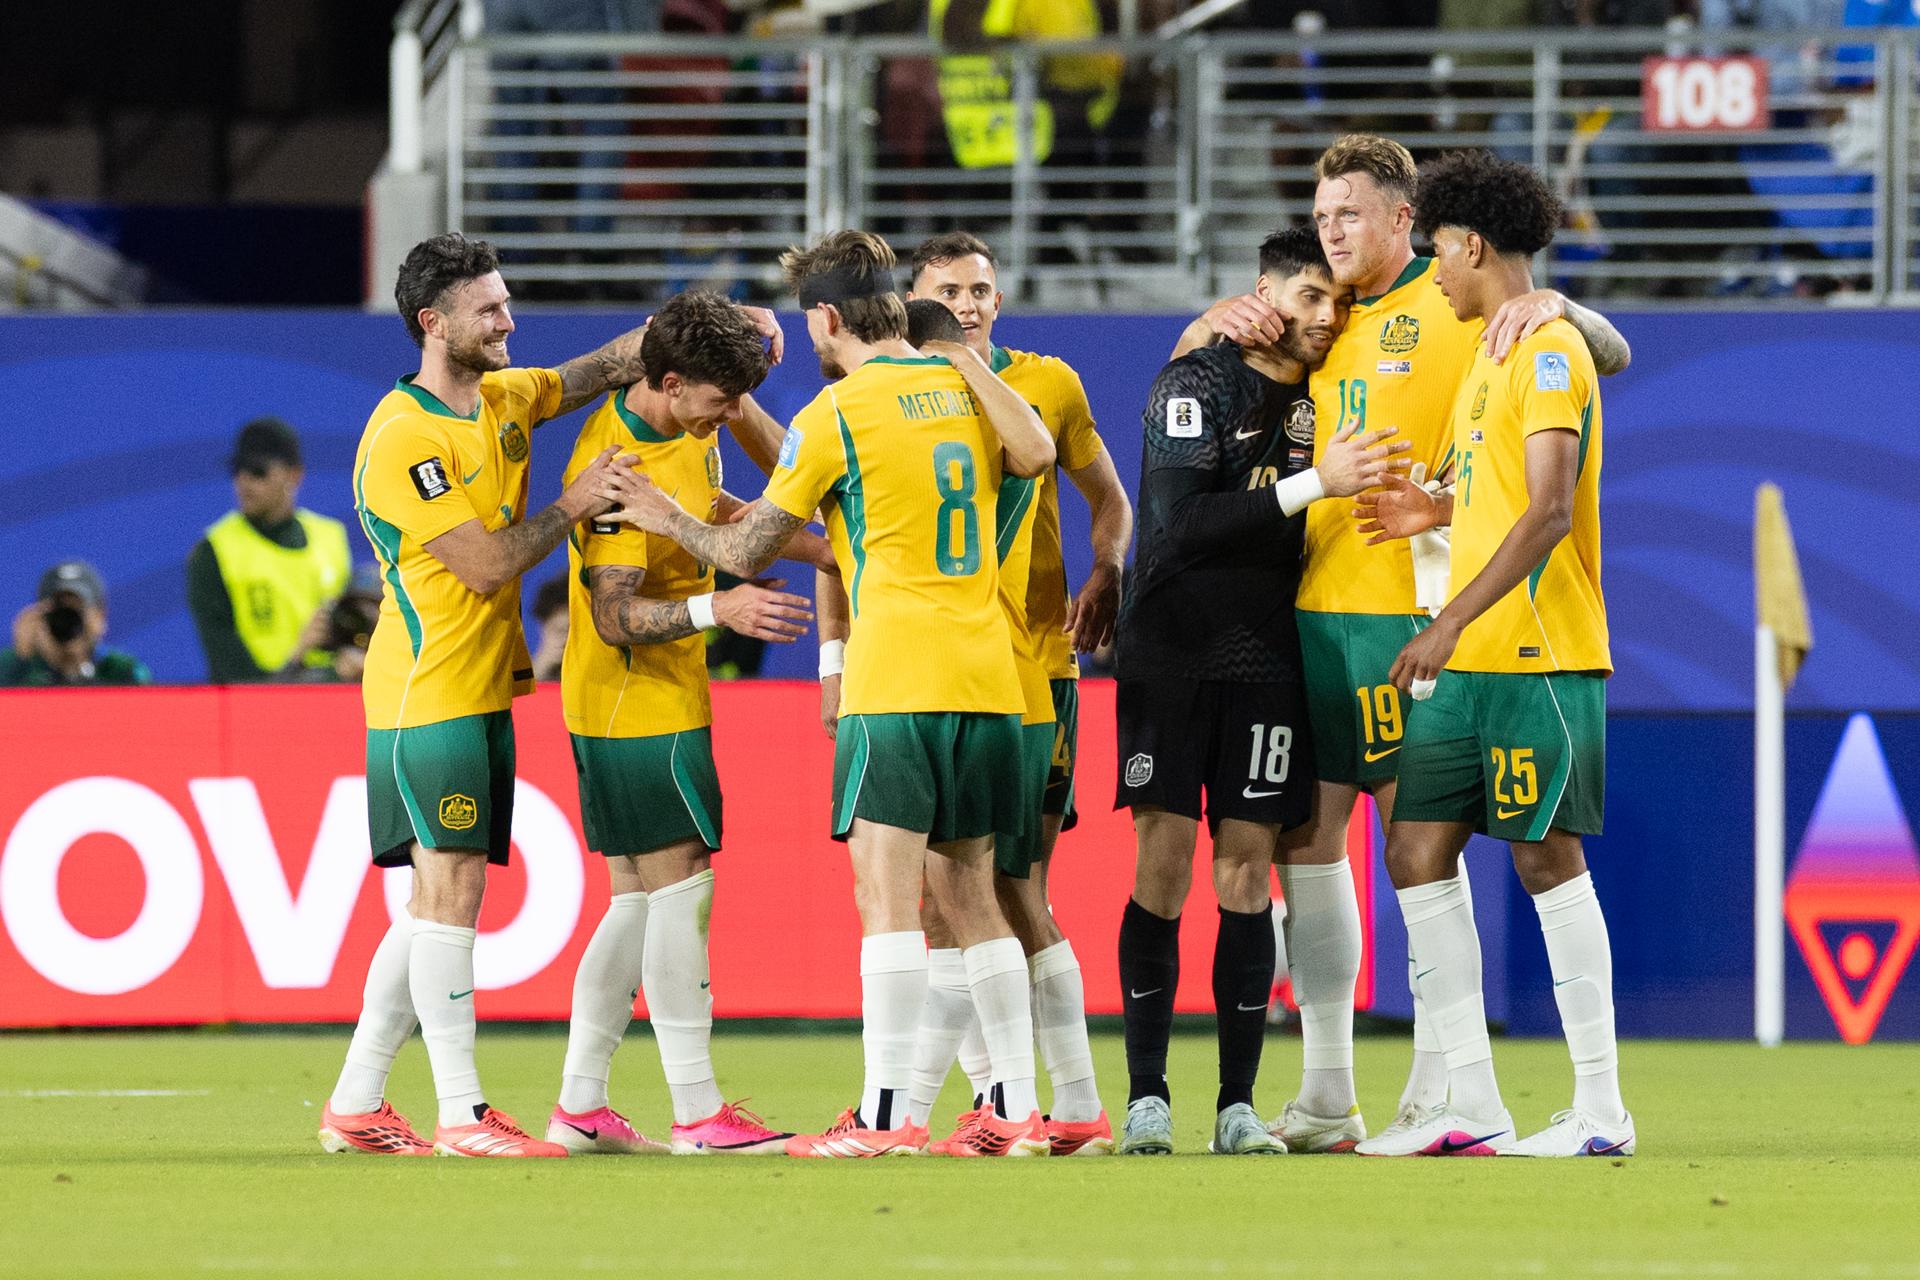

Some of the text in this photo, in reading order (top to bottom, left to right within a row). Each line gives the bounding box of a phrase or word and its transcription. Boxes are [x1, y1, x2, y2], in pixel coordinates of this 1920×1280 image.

[1651, 61, 1757, 128] 108
[897, 390, 980, 419] METCALFE
[1336, 378, 1367, 435] 19
[933, 440, 982, 577] 8
[1356, 684, 1403, 744] 19
[1248, 723, 1293, 783] 18
[1491, 746, 1538, 805] 25
